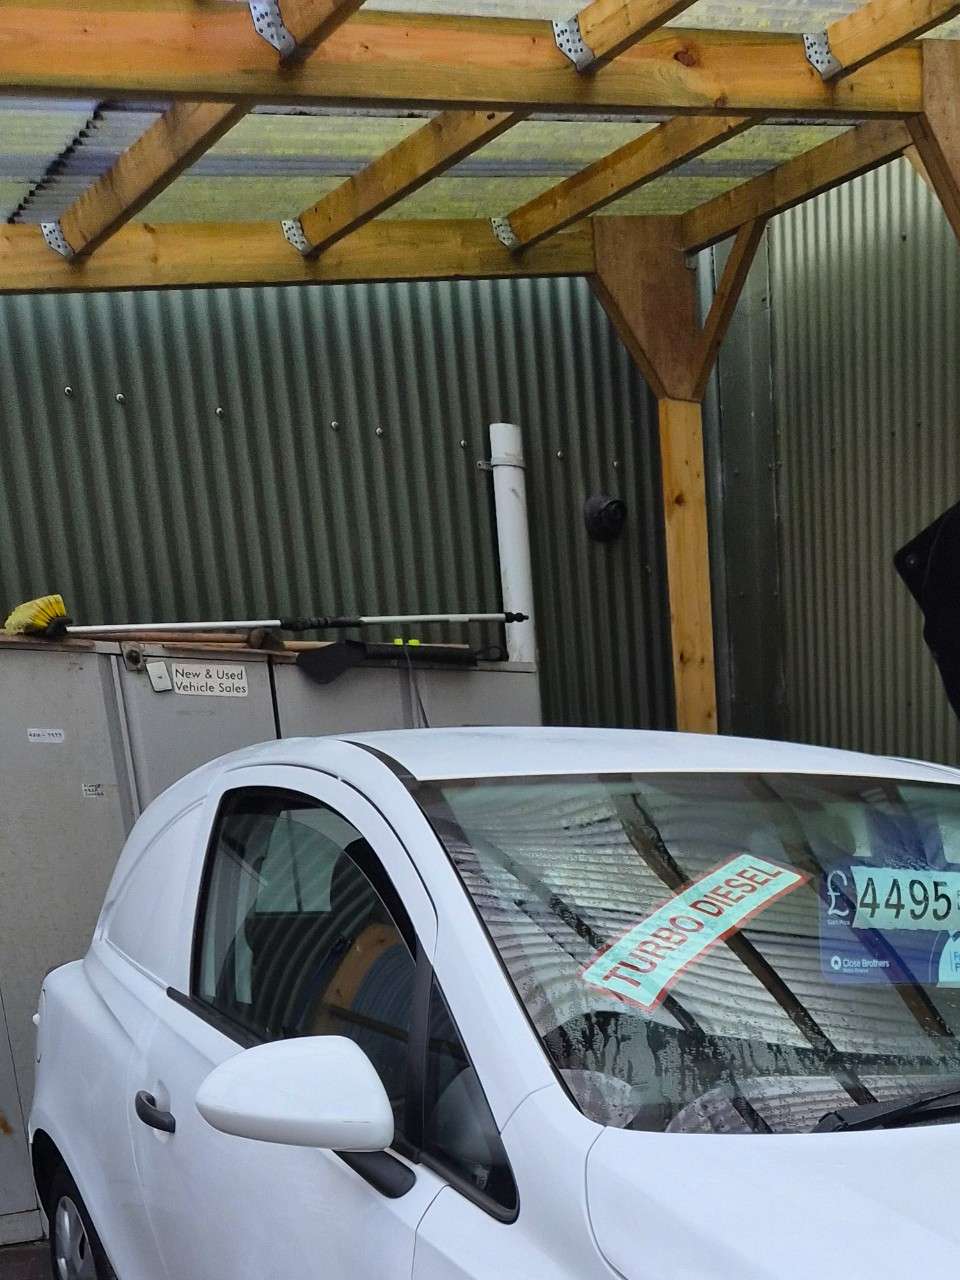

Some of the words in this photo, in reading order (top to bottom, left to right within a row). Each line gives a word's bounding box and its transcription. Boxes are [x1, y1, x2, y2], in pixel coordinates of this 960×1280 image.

[175, 668, 200, 678] New
[205, 668, 212, 679] &
[216, 669, 243, 680] Used
[175, 681, 215, 693] Vehicle
[218, 683, 247, 693] Sales
[602, 914, 704, 988] TURBO
[689, 865, 783, 917] DIESEL
[862, 959, 890, 968] Brothers
